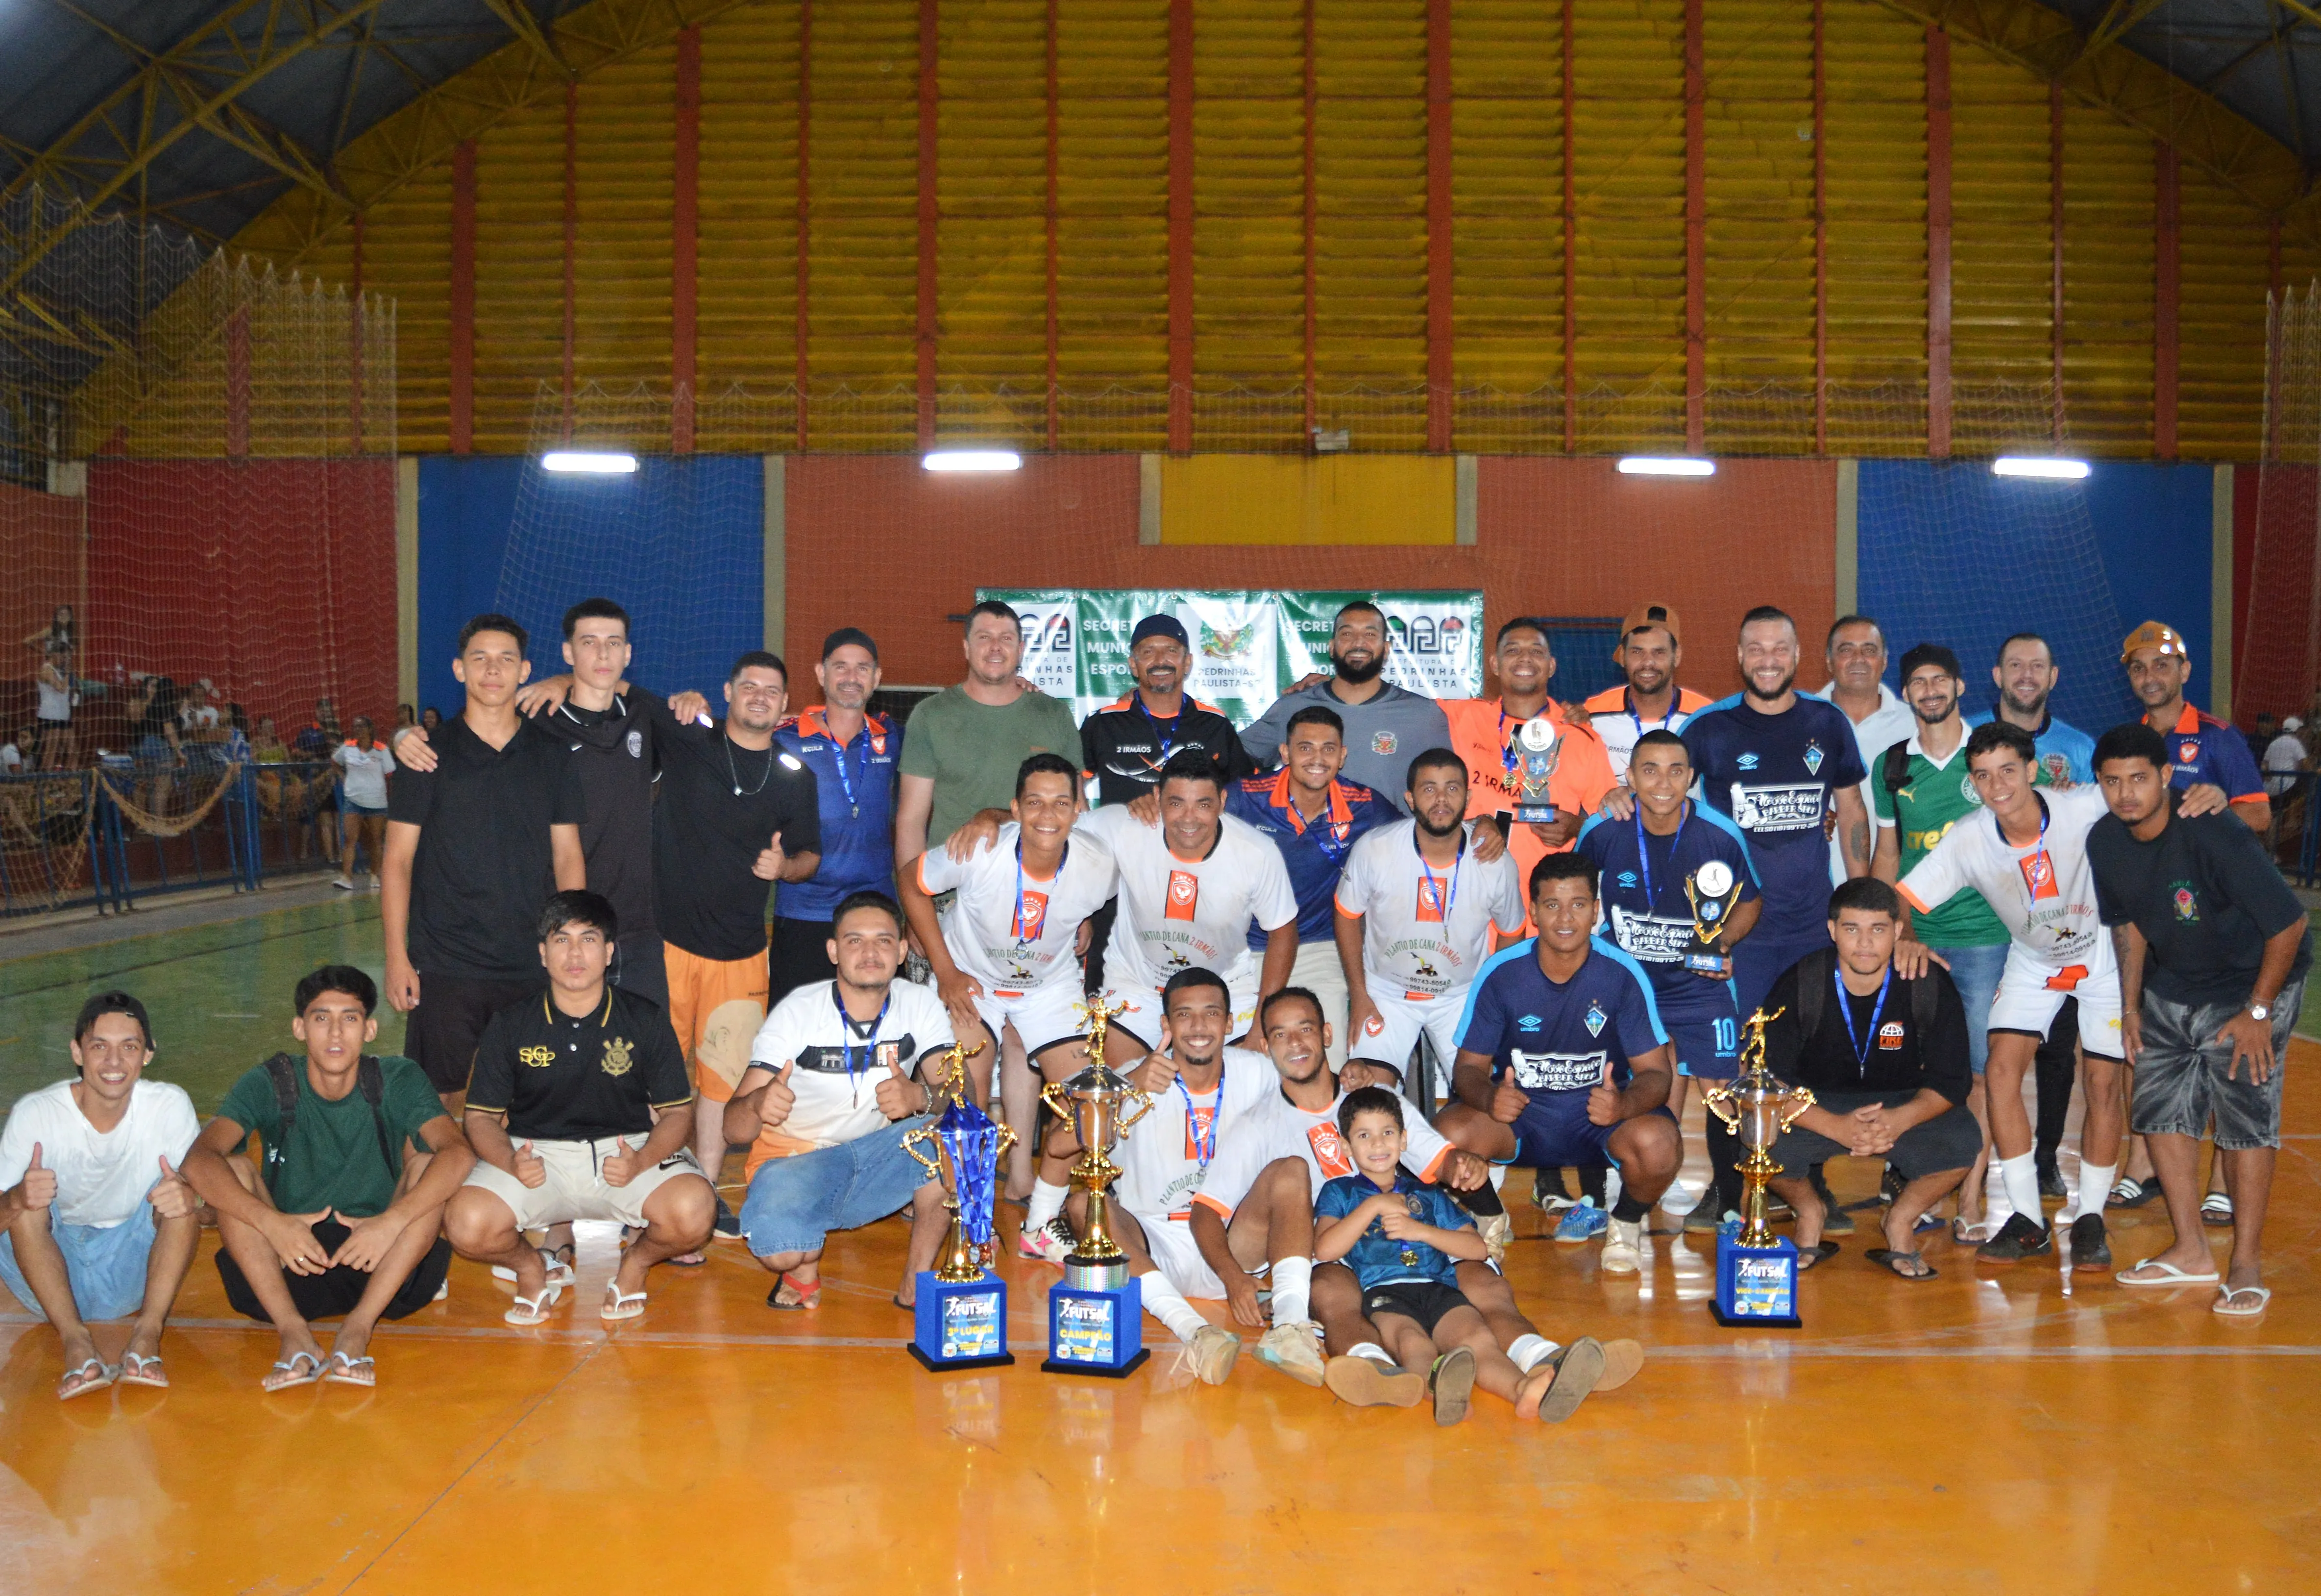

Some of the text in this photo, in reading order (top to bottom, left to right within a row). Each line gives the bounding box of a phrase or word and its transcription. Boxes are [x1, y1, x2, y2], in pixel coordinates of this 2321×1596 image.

[1123, 745, 1151, 753] IRMÃOS
[1472, 771, 1480, 784] 2
[1163, 931, 1171, 941] DE
[1173, 931, 1190, 944] CANA
[1189, 936, 1195, 945] 2
[1409, 939, 1417, 950] DE
[1419, 939, 1436, 951] CANA
[1436, 942, 1441, 952] 2
[1711, 1018, 1735, 1051] 10
[1159, 1178, 1185, 1205] PLANTIO
[1185, 1174, 1194, 1186] DE
[1747, 1266, 1787, 1277] FUTSAL
[955, 1301, 996, 1316] FUTSAL
[1069, 1307, 1110, 1321] FUTSAL
[960, 1325, 994, 1336] LUGAR
[1060, 1328, 1112, 1342] CAMPEÃO
